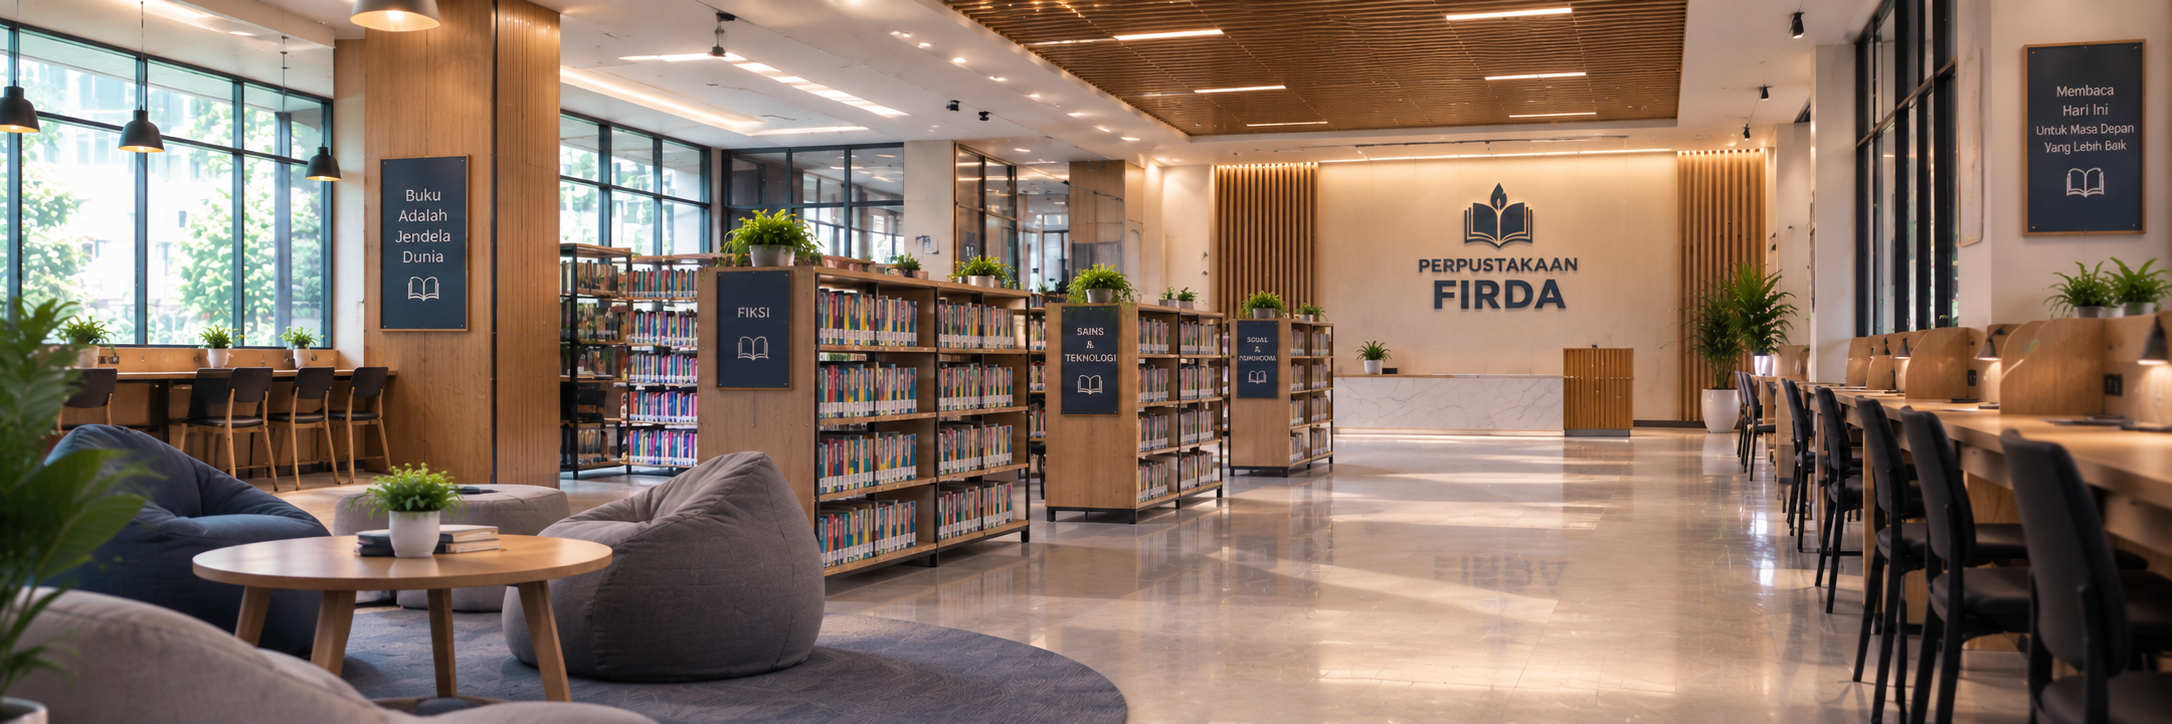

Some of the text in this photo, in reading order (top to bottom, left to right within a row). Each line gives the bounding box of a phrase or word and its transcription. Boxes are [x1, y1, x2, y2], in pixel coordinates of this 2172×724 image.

[2056, 84, 2114, 97] Membaca
[2062, 103, 2109, 117] Hari Ini
[2036, 123, 2135, 136] Untuk Masa Depan
[2044, 142, 2071, 155] Yang
[2073, 141, 2102, 152] Lebih
[405, 188, 441, 202] Buku
[398, 208, 448, 222] Adalah
[395, 228, 451, 243] Jendela
[402, 249, 444, 263] Dunia
[1418, 257, 1579, 273] PERPUSTAKAAN
[1433, 278, 1567, 310] FIRDA
[737, 306, 770, 319] FIKSI
[1076, 327, 1104, 336] SAINS
[1086, 340, 1095, 349] &
[1064, 353, 1117, 362] TEKNOLOGI
